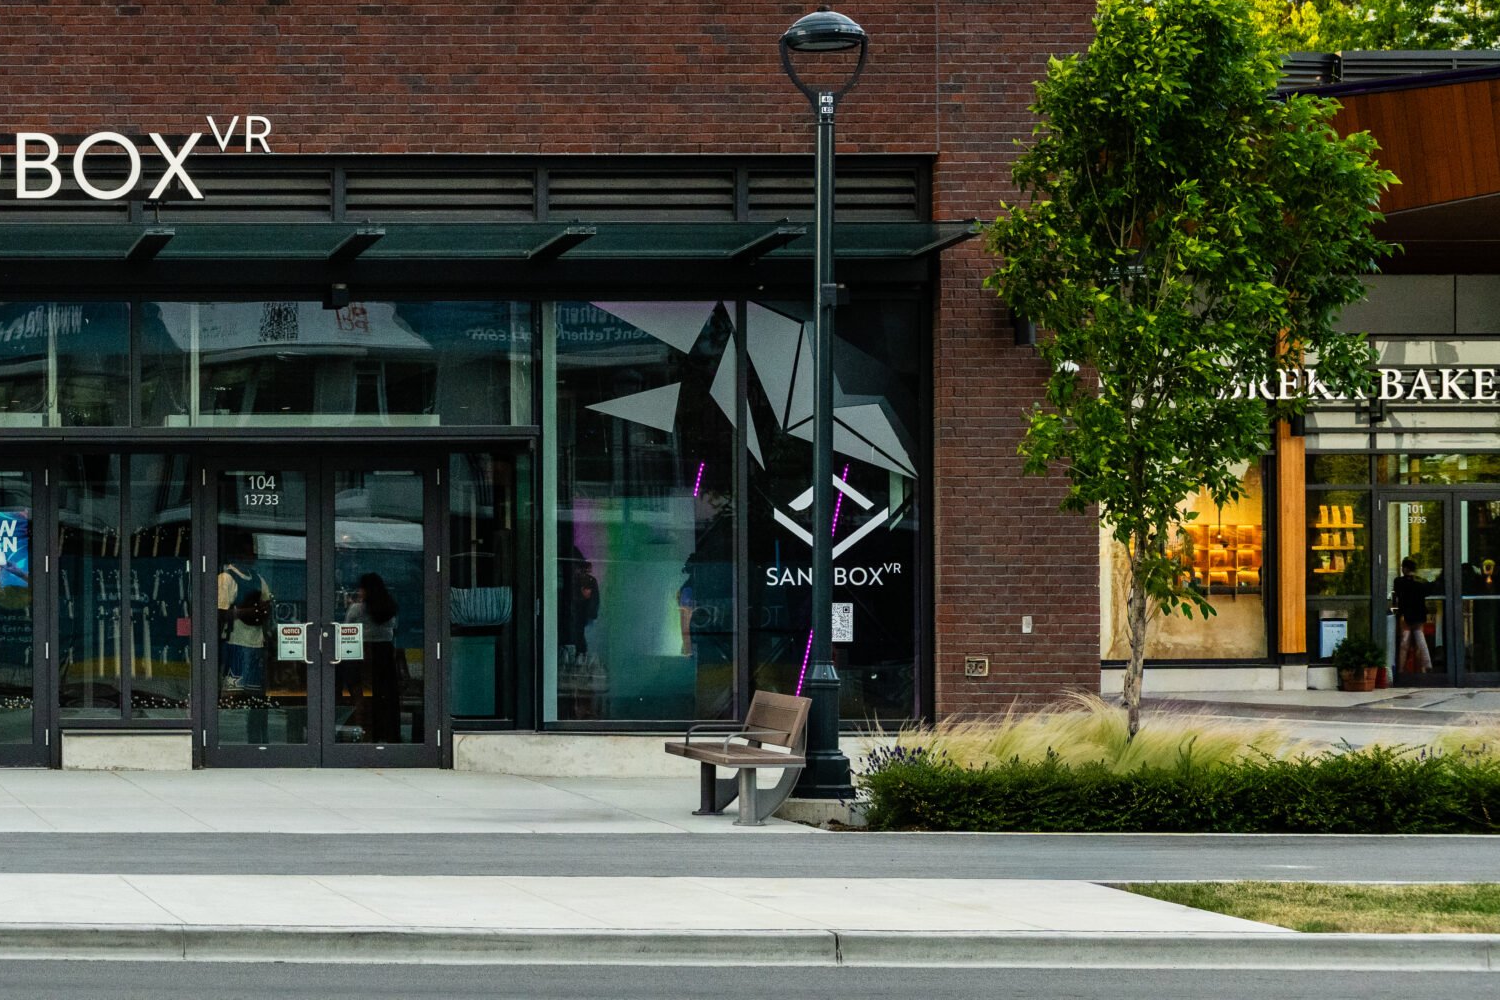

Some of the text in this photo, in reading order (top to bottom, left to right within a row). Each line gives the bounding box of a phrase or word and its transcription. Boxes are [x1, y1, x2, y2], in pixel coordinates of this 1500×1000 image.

[206, 115, 272, 154] VR
[1378, 368, 1498, 400] BAKE
[248, 475, 276, 490] 104
[244, 494, 279, 505] 13733
[1407, 504, 1424, 514] 101
[765, 562, 902, 586] SANBOX VR
